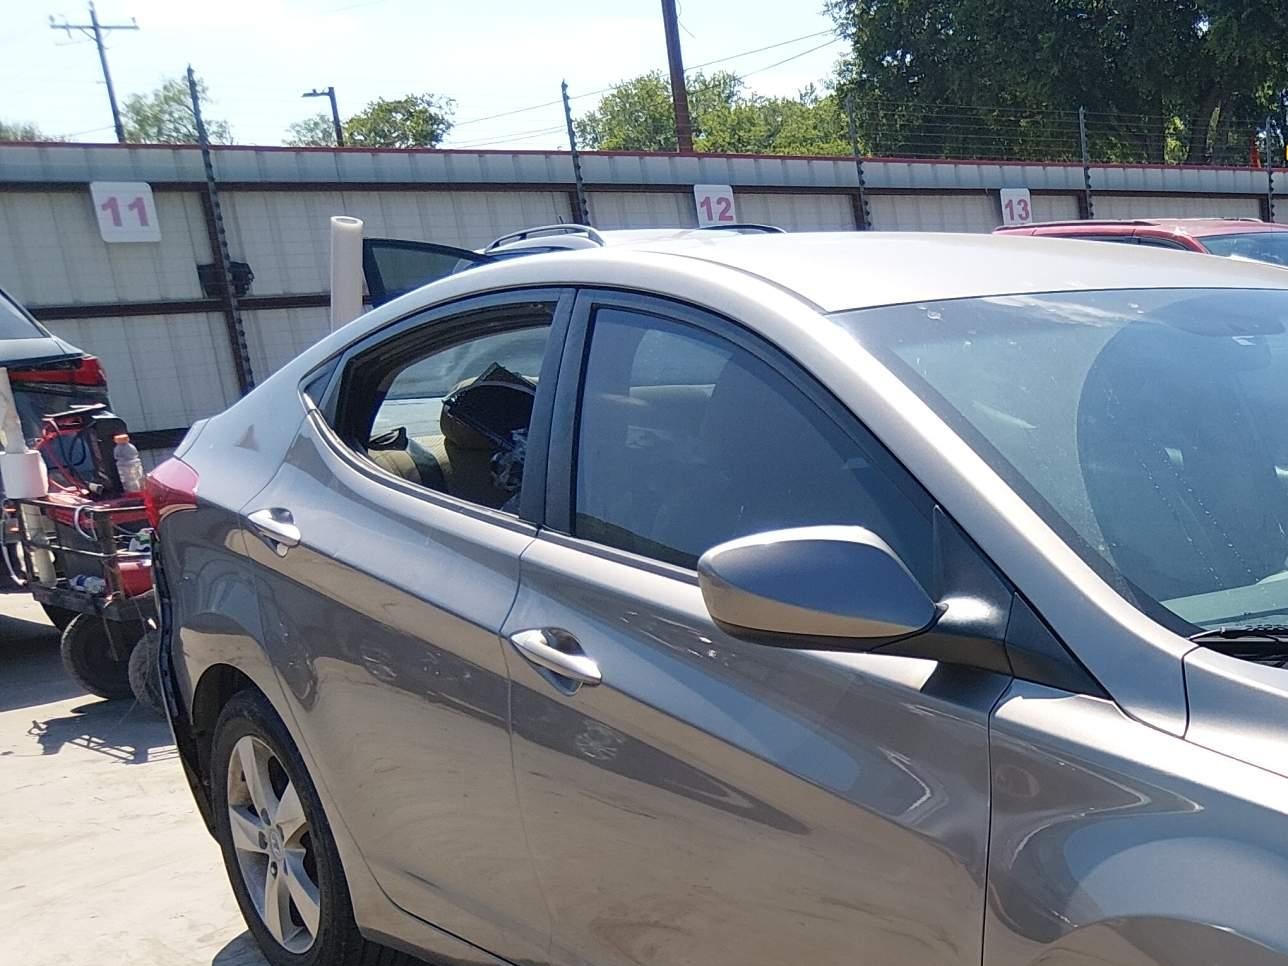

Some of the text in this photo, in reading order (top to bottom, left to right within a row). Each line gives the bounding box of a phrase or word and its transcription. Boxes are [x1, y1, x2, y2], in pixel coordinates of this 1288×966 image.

[101, 196, 149, 227] 11
[700, 196, 734, 222] 12
[1004, 198, 1030, 221] 13
